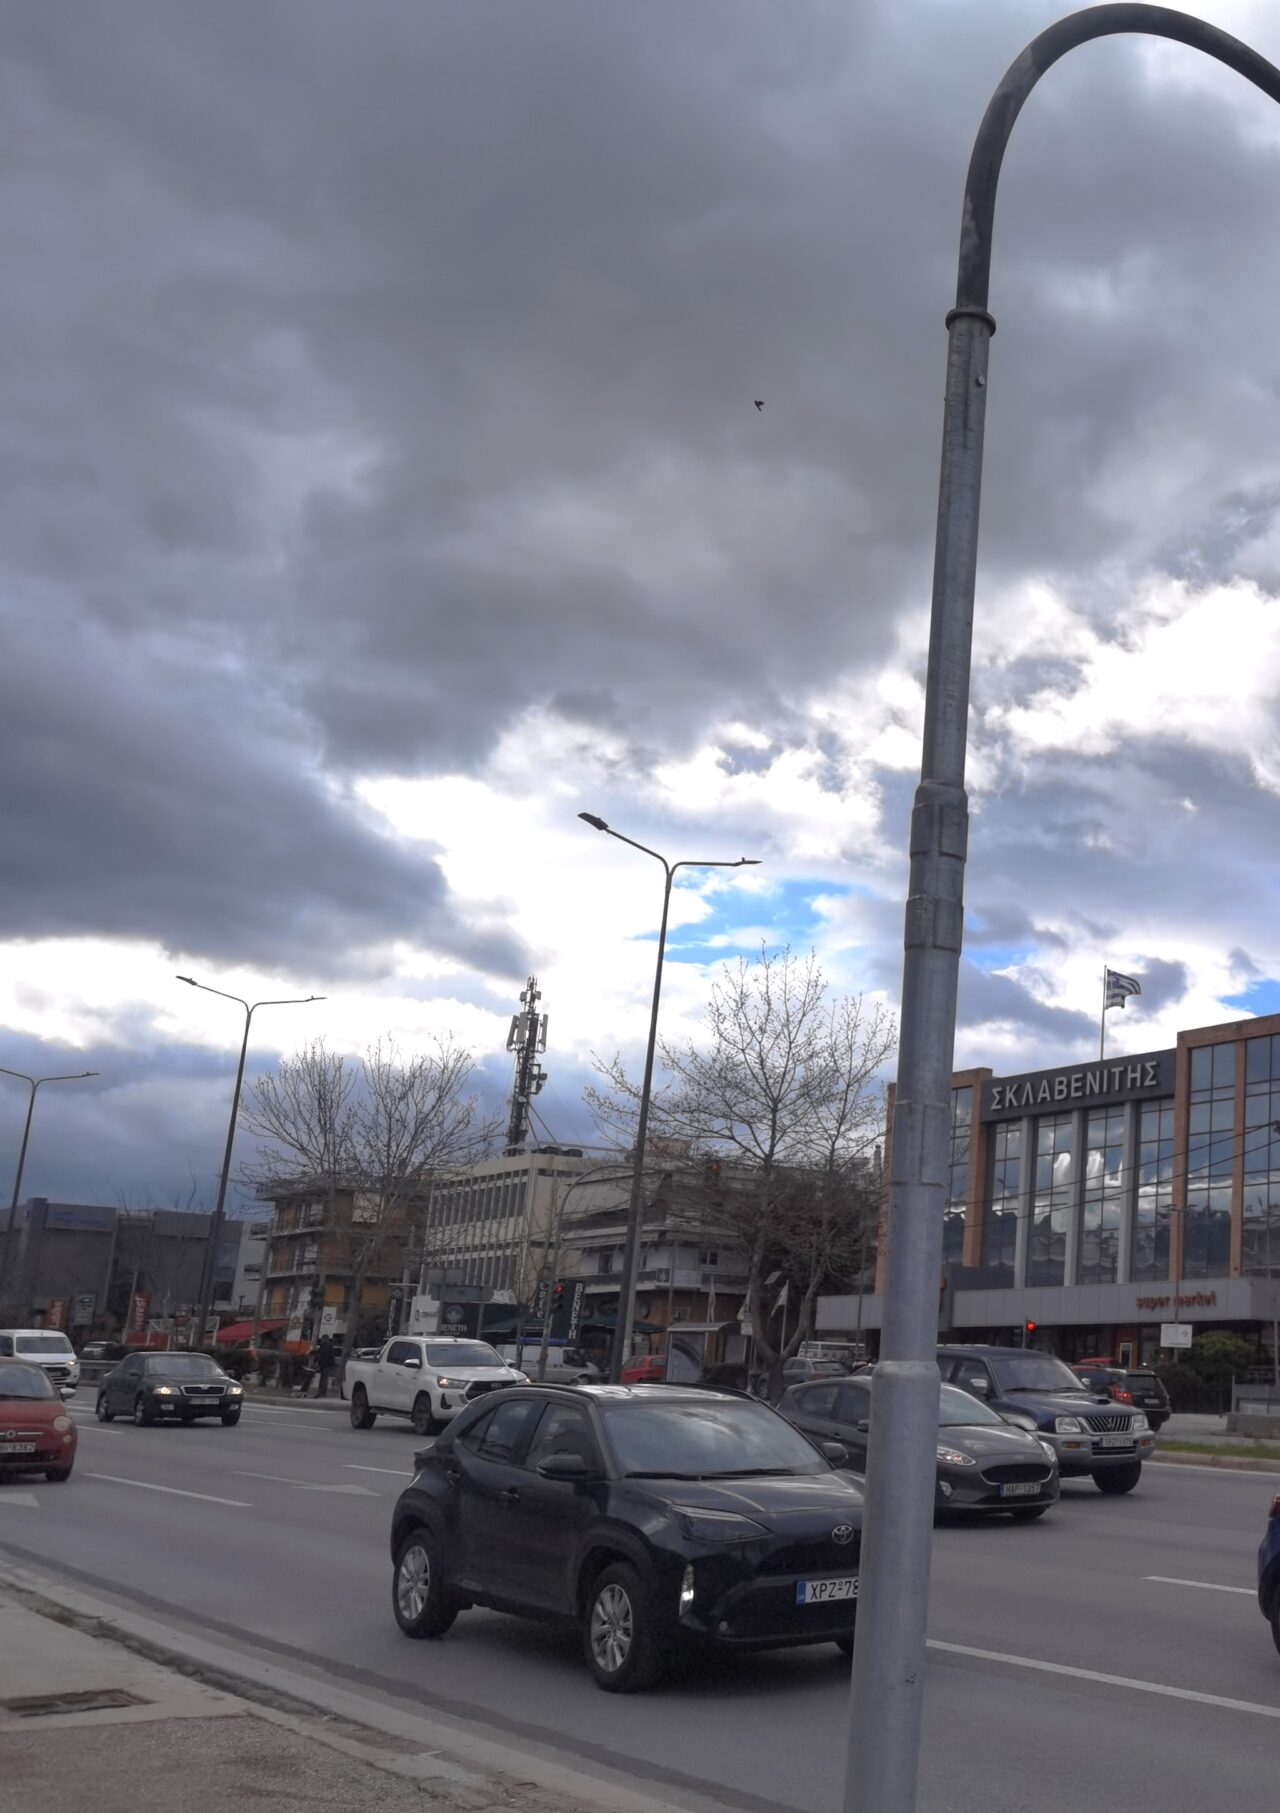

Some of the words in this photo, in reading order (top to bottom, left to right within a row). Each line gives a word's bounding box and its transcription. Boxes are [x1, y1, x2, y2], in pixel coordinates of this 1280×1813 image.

[991, 1061, 1158, 1110] ΣΚΛΑΒΕΝΙΤΗΣ
[568, 1283, 584, 1339] BENETH
[1136, 1296, 1169, 1312] super
[810, 1580, 858, 1600] XPZ-78
